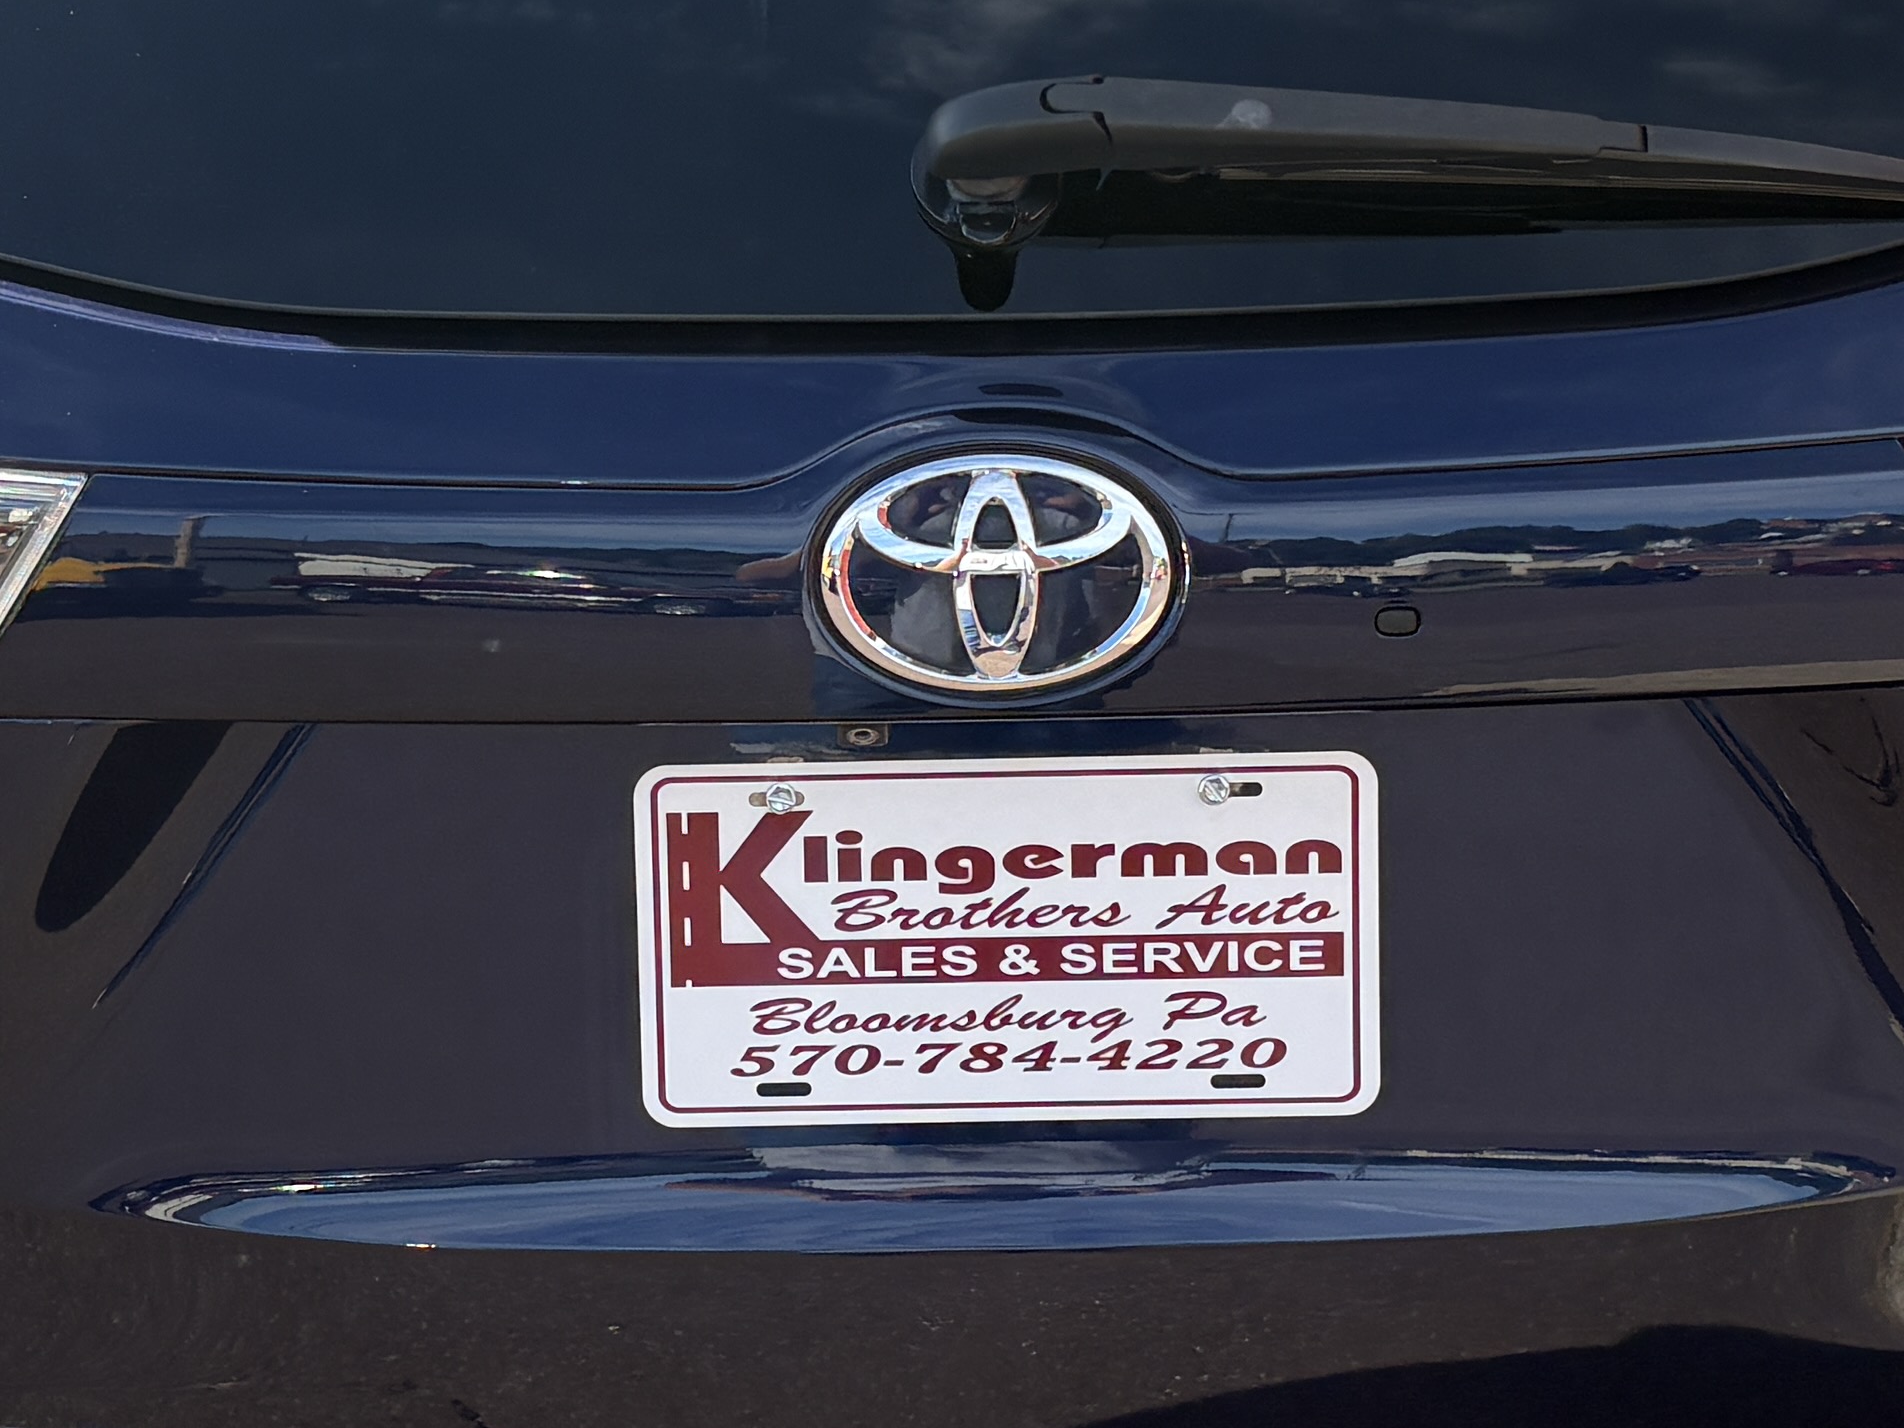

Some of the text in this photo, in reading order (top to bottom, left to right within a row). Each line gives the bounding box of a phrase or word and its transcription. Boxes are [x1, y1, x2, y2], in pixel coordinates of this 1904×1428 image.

[666, 810, 1344, 972] Klingerman
[831, 883, 1340, 933] Brothers Auto
[777, 939, 1326, 980] SALES & SERVICE
[750, 990, 1267, 1043] Bloomsburg Pa
[730, 1037, 1289, 1078] 570-784-4220
